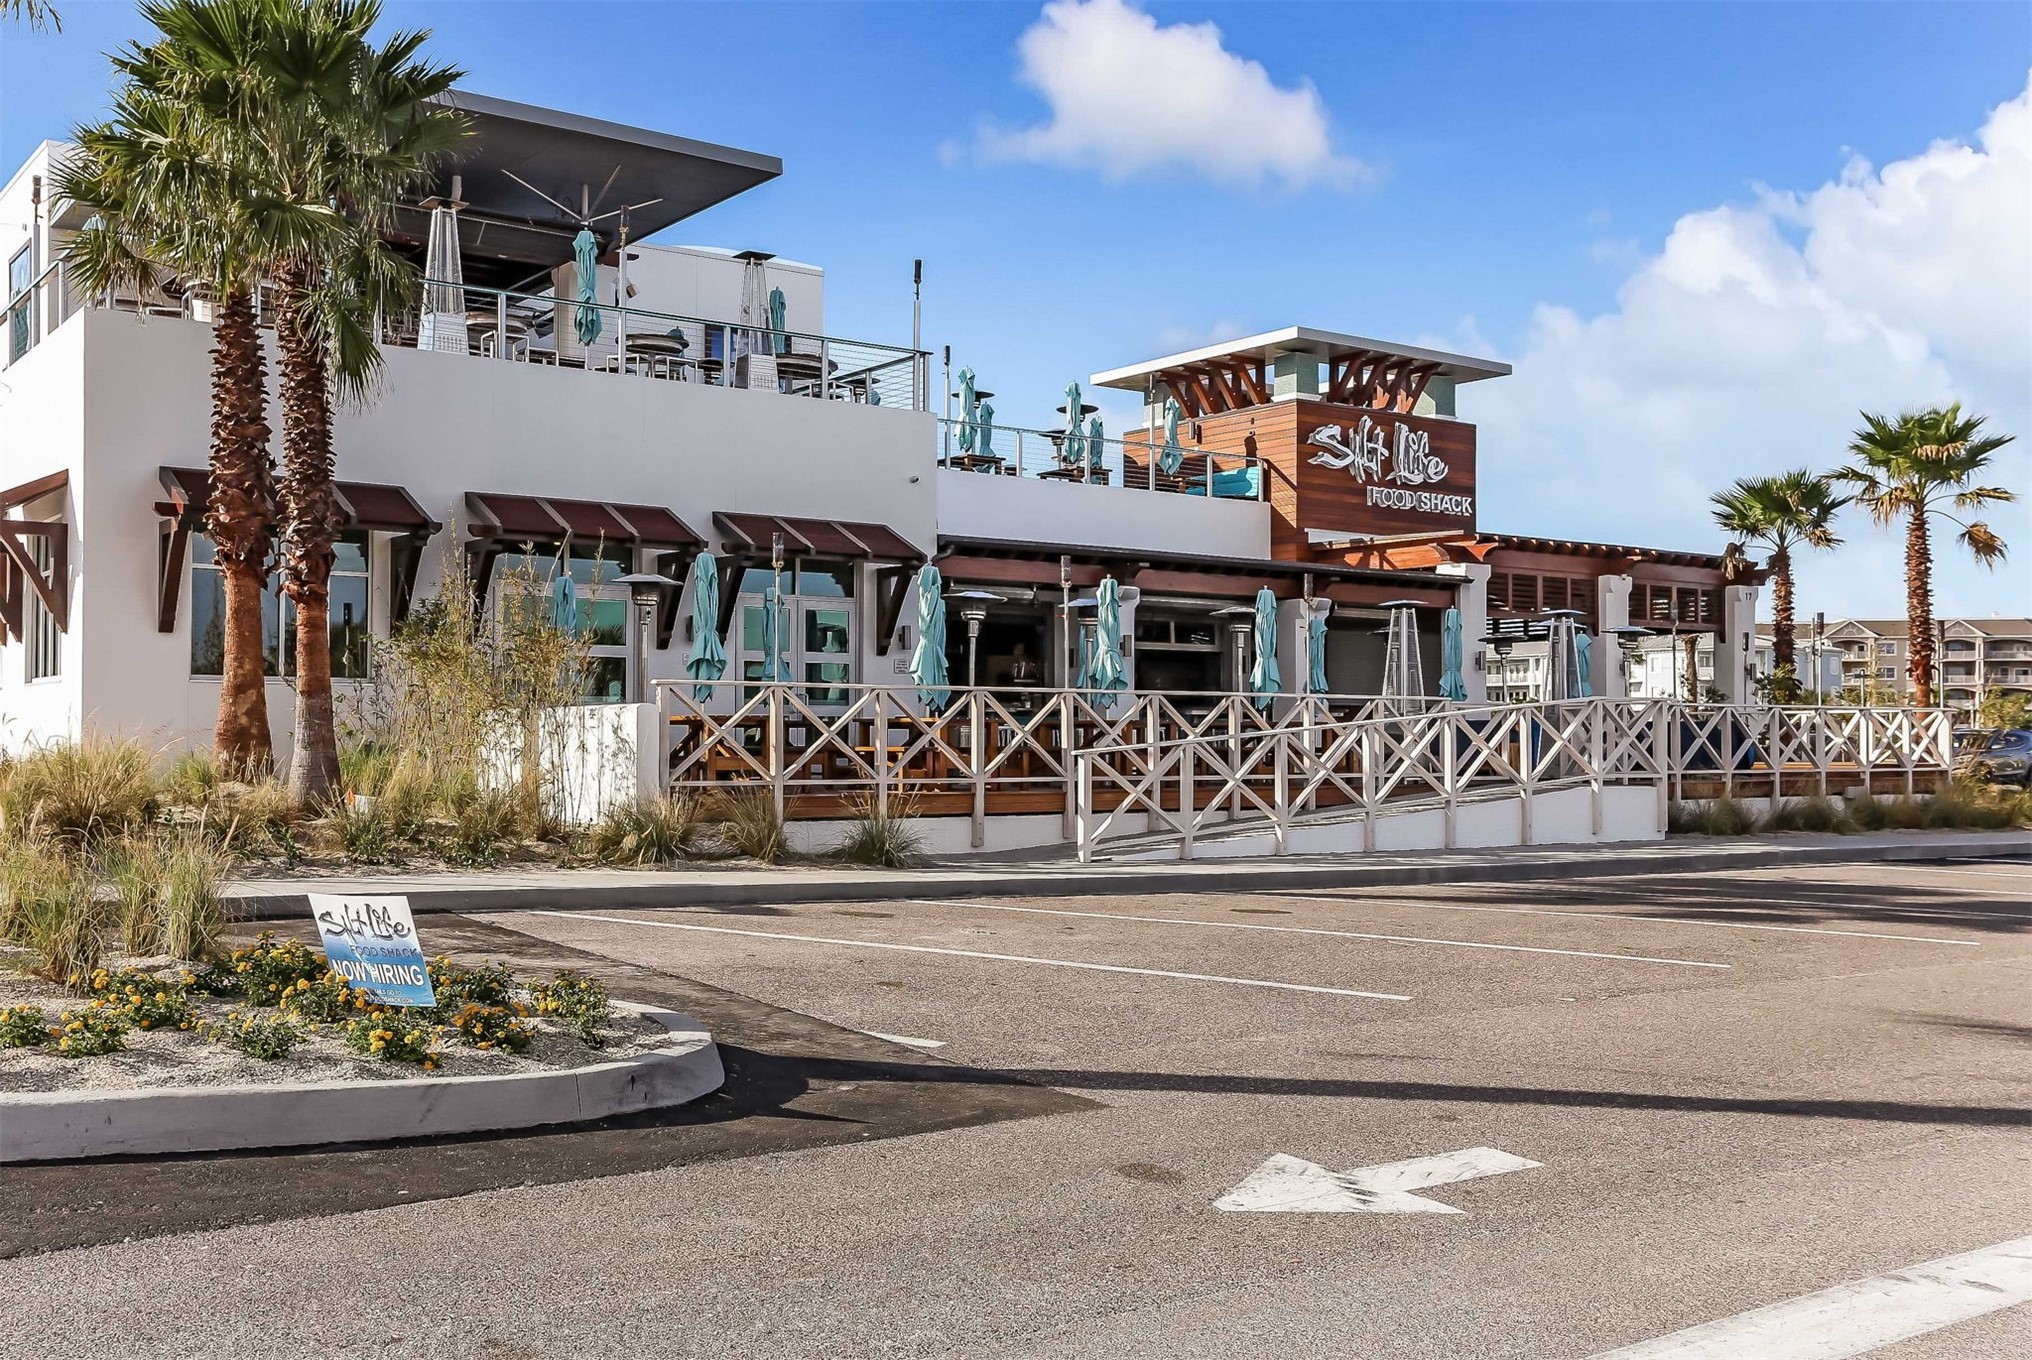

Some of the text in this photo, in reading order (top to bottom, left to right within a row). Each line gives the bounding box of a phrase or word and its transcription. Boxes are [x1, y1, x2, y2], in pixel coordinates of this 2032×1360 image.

[1367, 486, 1473, 516] FOOD SHACK
[1745, 592, 1752, 601] 17
[350, 945, 420, 958] FOOD SHACK
[331, 958, 424, 986] NOW HIRING
